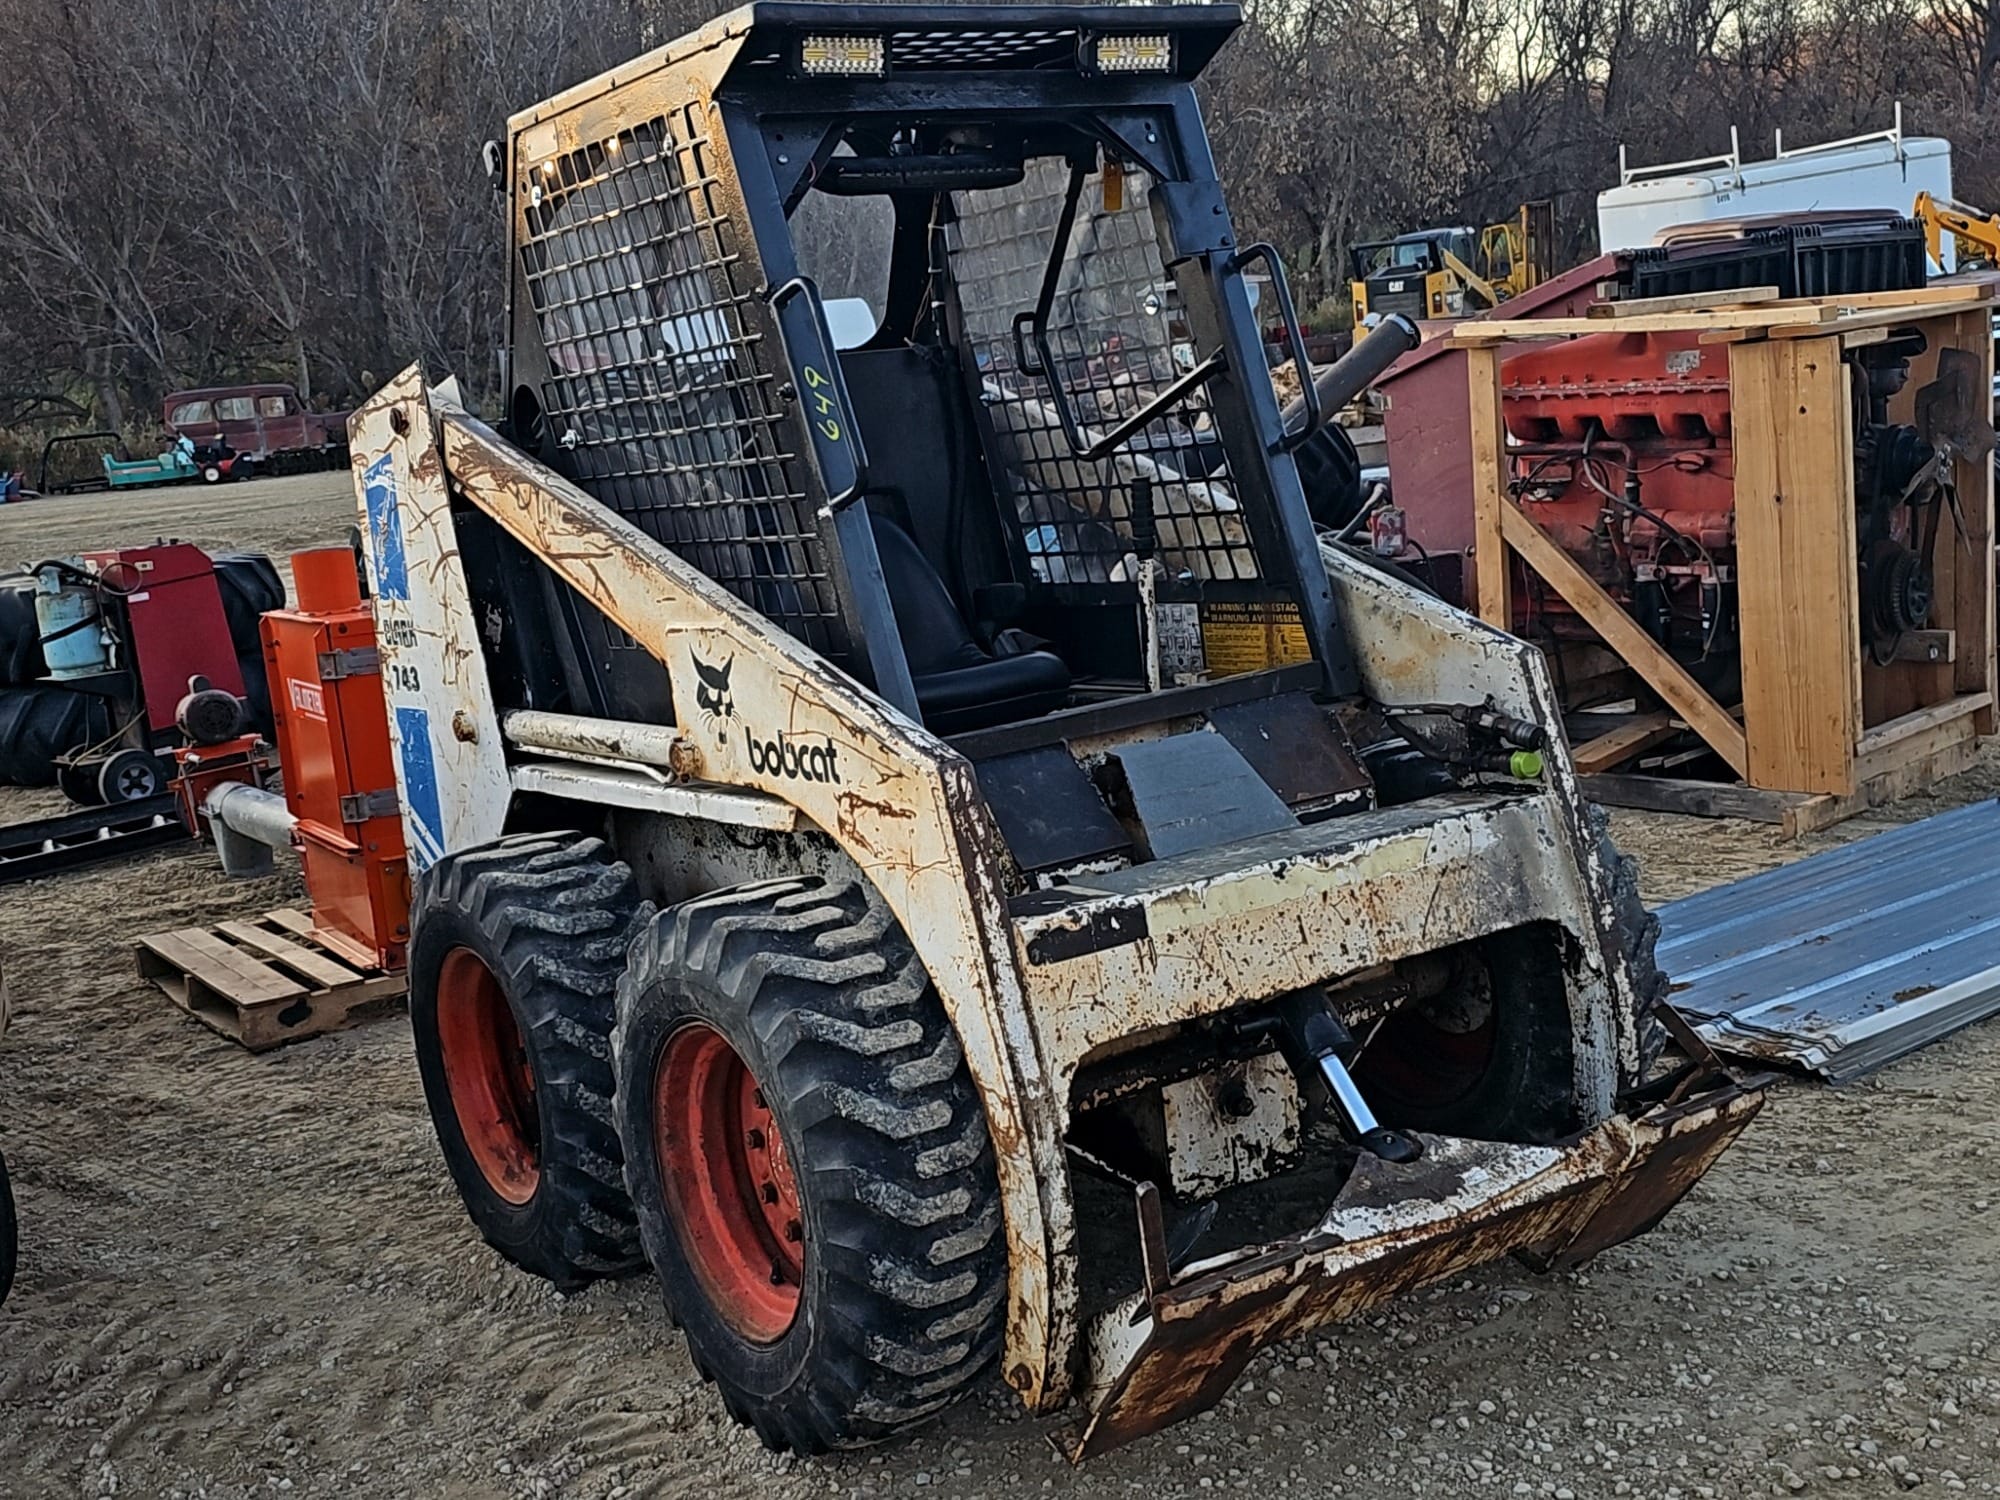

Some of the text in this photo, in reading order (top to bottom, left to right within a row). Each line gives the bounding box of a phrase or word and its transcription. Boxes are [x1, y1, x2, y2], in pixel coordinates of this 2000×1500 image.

[1388, 281, 1405, 292] CAT
[804, 366, 841, 441] 649
[1210, 603, 1246, 612] WARNING
[1211, 613, 1249, 622] WARNUNG
[392, 665, 420, 692] 743
[744, 726, 841, 785] bobcat
